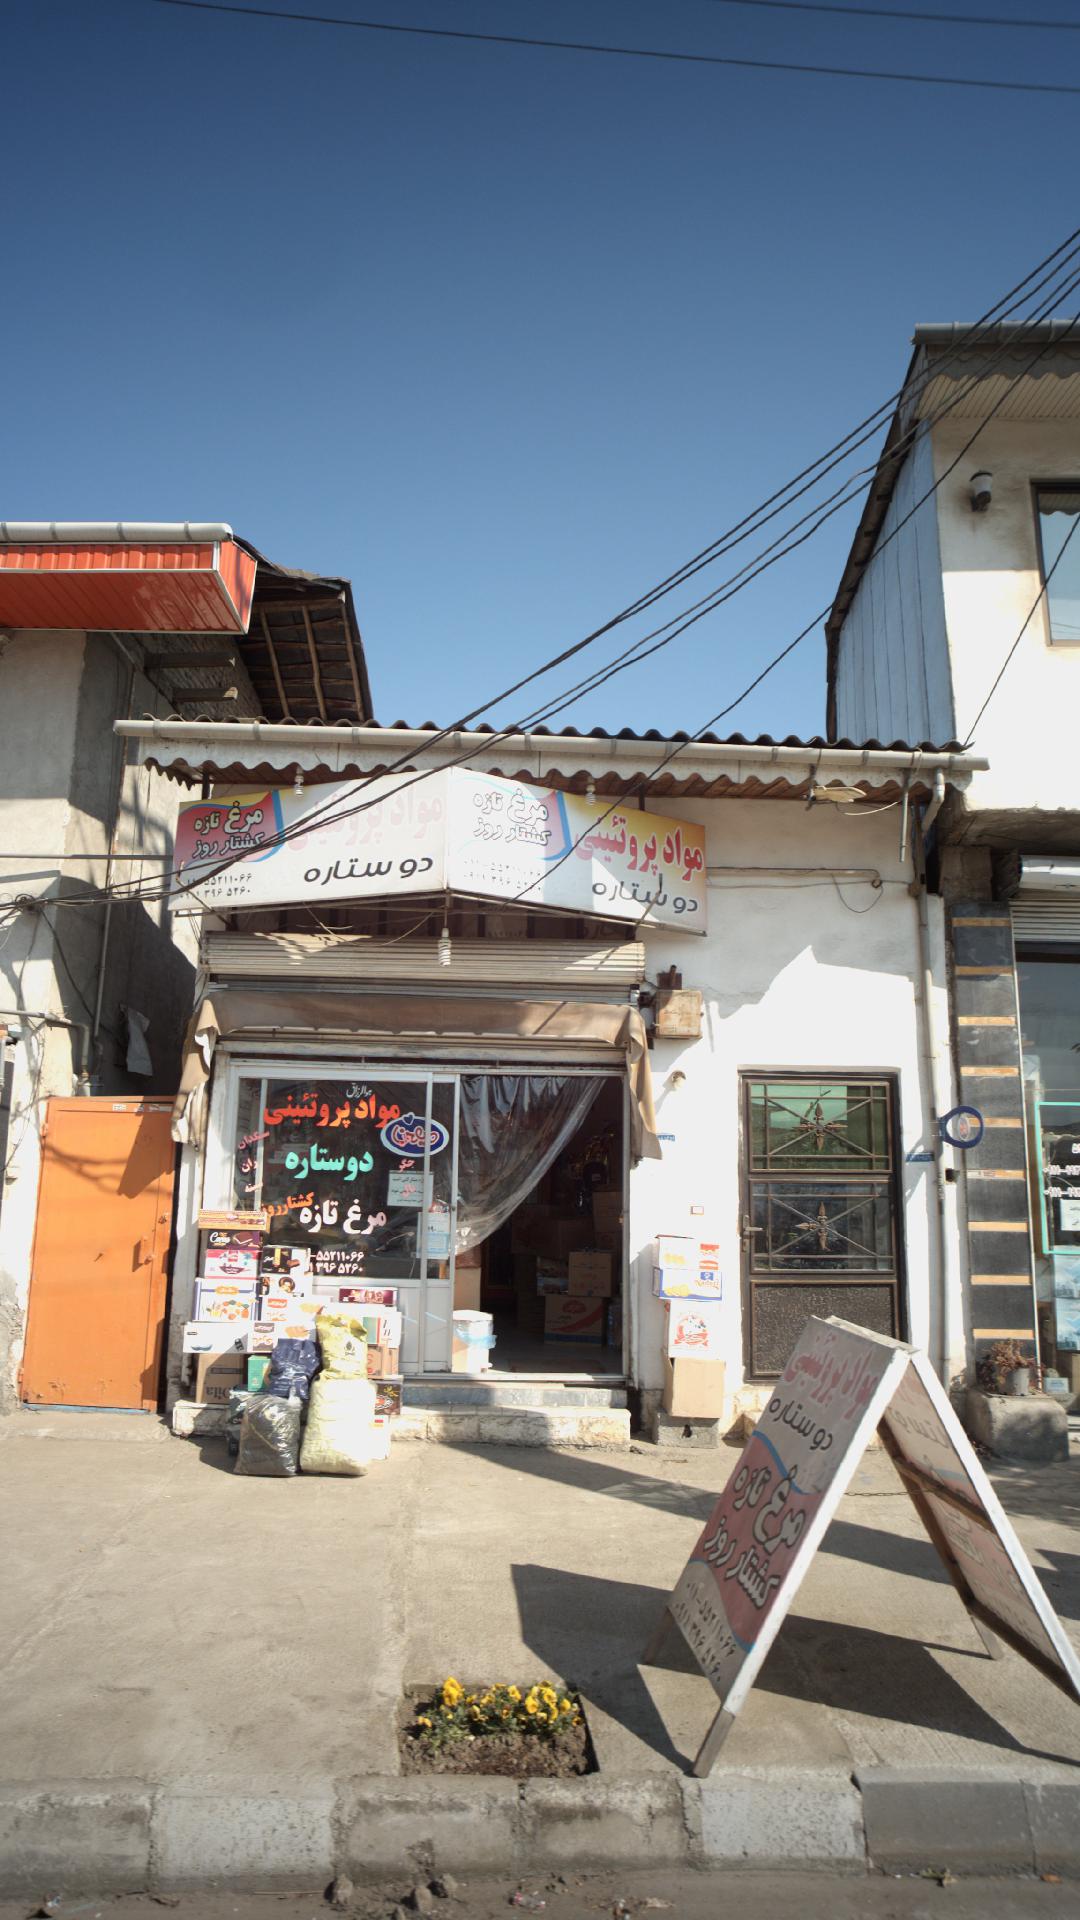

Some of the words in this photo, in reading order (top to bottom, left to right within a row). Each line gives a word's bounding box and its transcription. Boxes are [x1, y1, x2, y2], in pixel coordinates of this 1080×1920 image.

[224, 801, 263, 833] مرغ
[473, 791, 503, 814] تازه
[506, 788, 549, 826] مرغ
[194, 811, 220, 835] تازه
[473, 817, 503, 840] روز
[505, 823, 552, 846] کشتار
[192, 840, 218, 859] روز
[220, 832, 265, 855] کشتار
[662, 829, 703, 881] مواد
[304, 858, 392, 886] ستاره
[263, 1092, 351, 1129] پروتئینی
[354, 1094, 400, 1129] مواد
[300, 1200, 338, 1233] تازه
[343, 1199, 387, 1235] مرغ
[842, 1349, 878, 1420] مواد
[732, 1465, 772, 1512] تازه
[753, 1464, 806, 1556] مرغ
[703, 1515, 737, 1568] روز
[724, 1545, 782, 1609] کشتار
